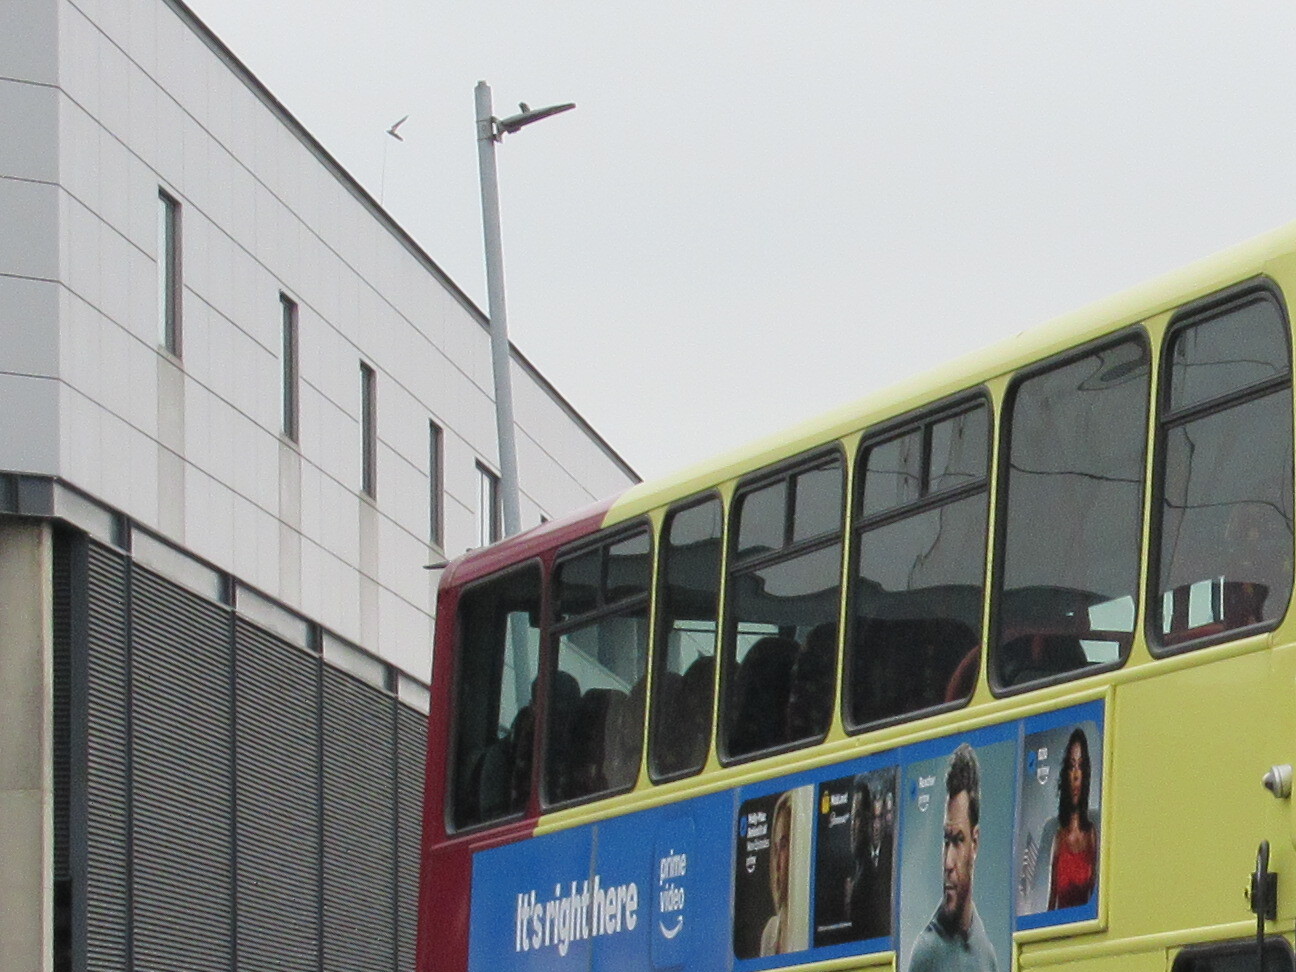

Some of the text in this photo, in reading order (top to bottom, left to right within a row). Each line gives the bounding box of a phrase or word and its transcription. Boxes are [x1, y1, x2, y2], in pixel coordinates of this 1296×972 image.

[659, 849, 687, 886] prime
[515, 874, 639, 957] It's right here
[659, 882, 685, 913] video
